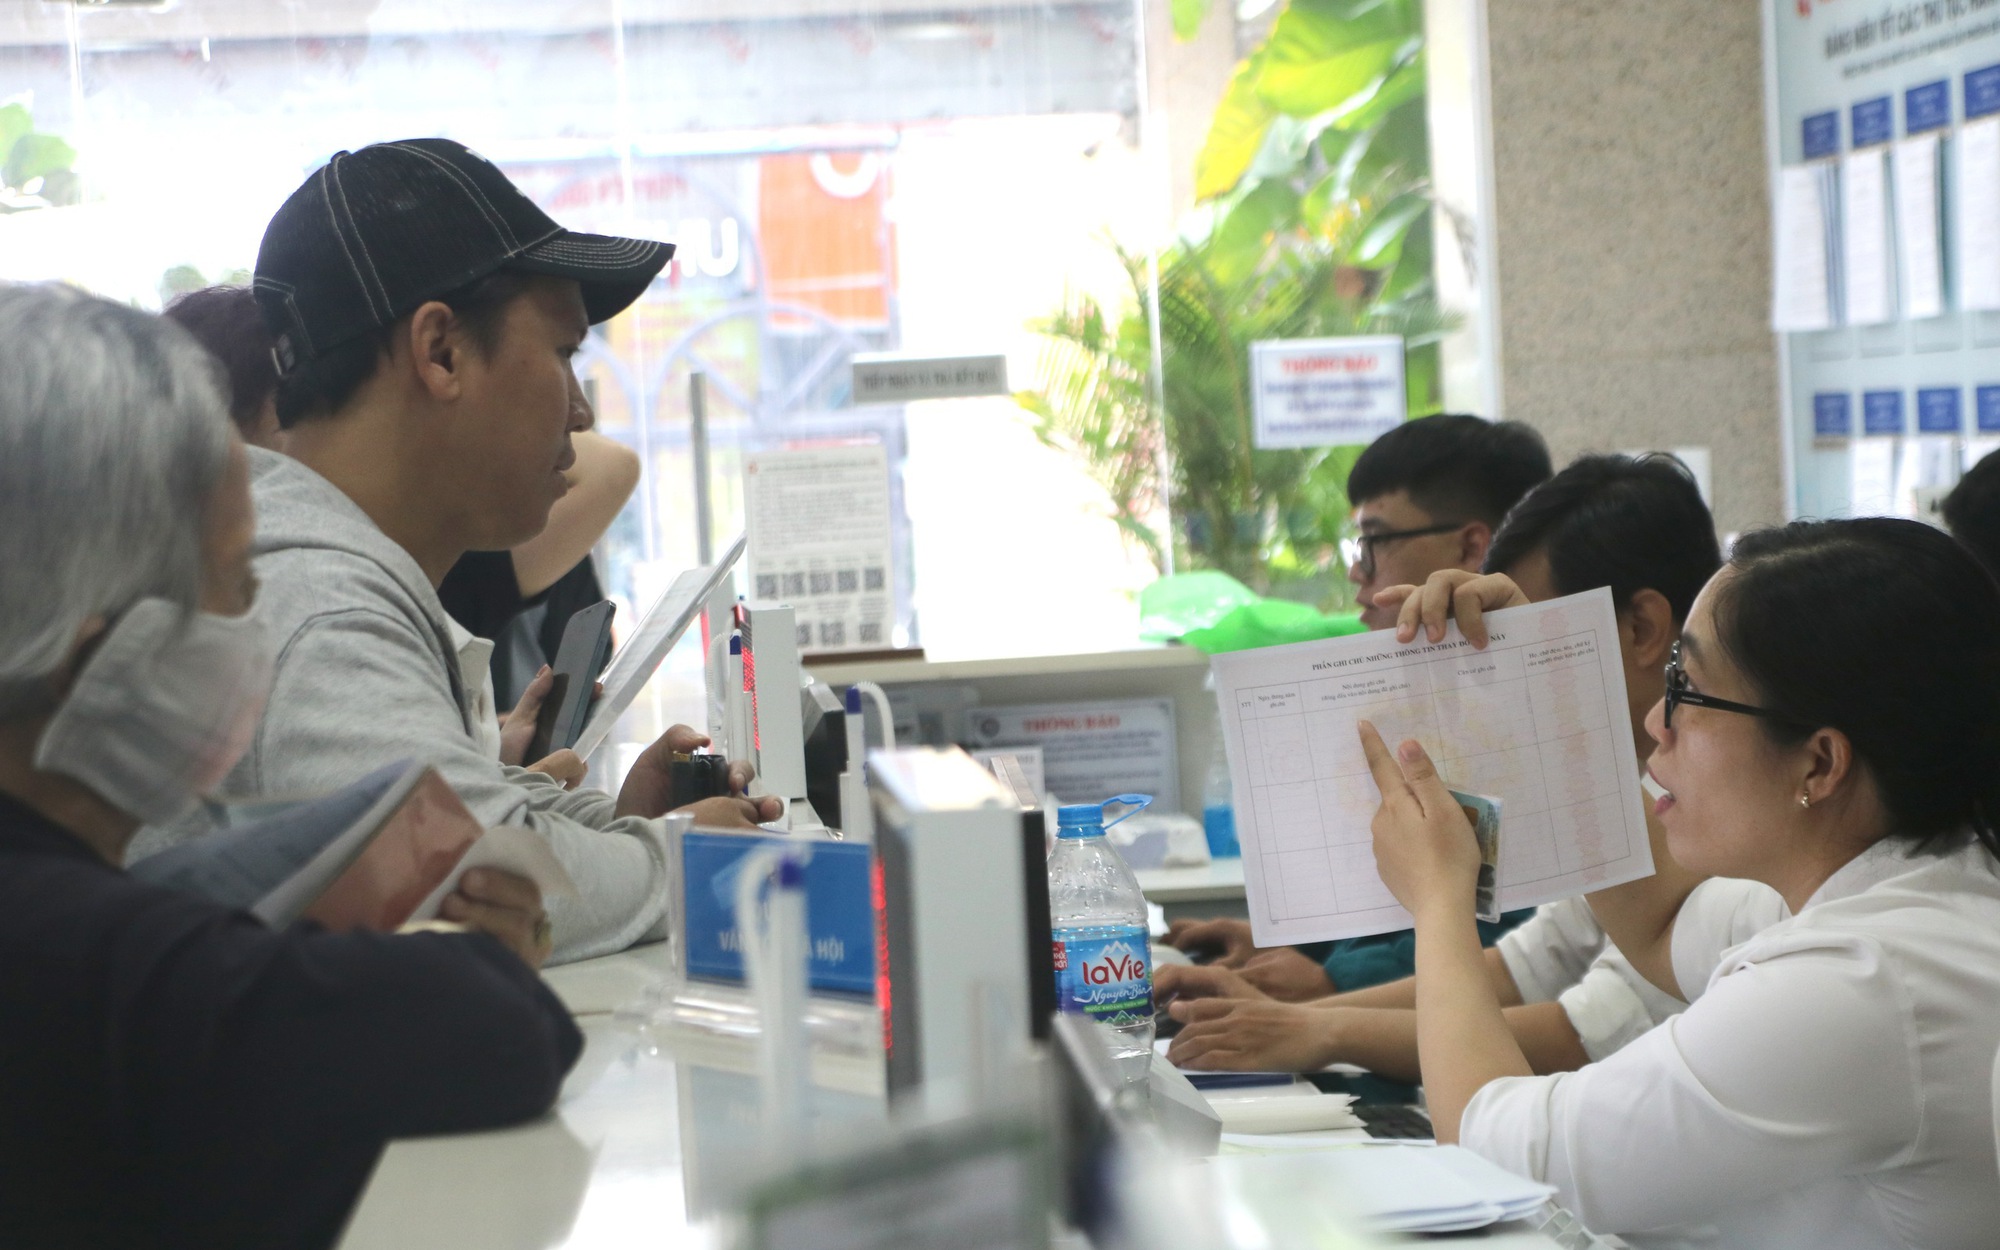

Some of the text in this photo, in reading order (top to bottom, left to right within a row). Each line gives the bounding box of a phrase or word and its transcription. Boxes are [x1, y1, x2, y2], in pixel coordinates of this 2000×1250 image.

[1334, 660, 1348, 668] GHI
[1394, 647, 1421, 658] THÔNG
[1422, 646, 1436, 654] TIN
[1437, 642, 1458, 651] THAY
